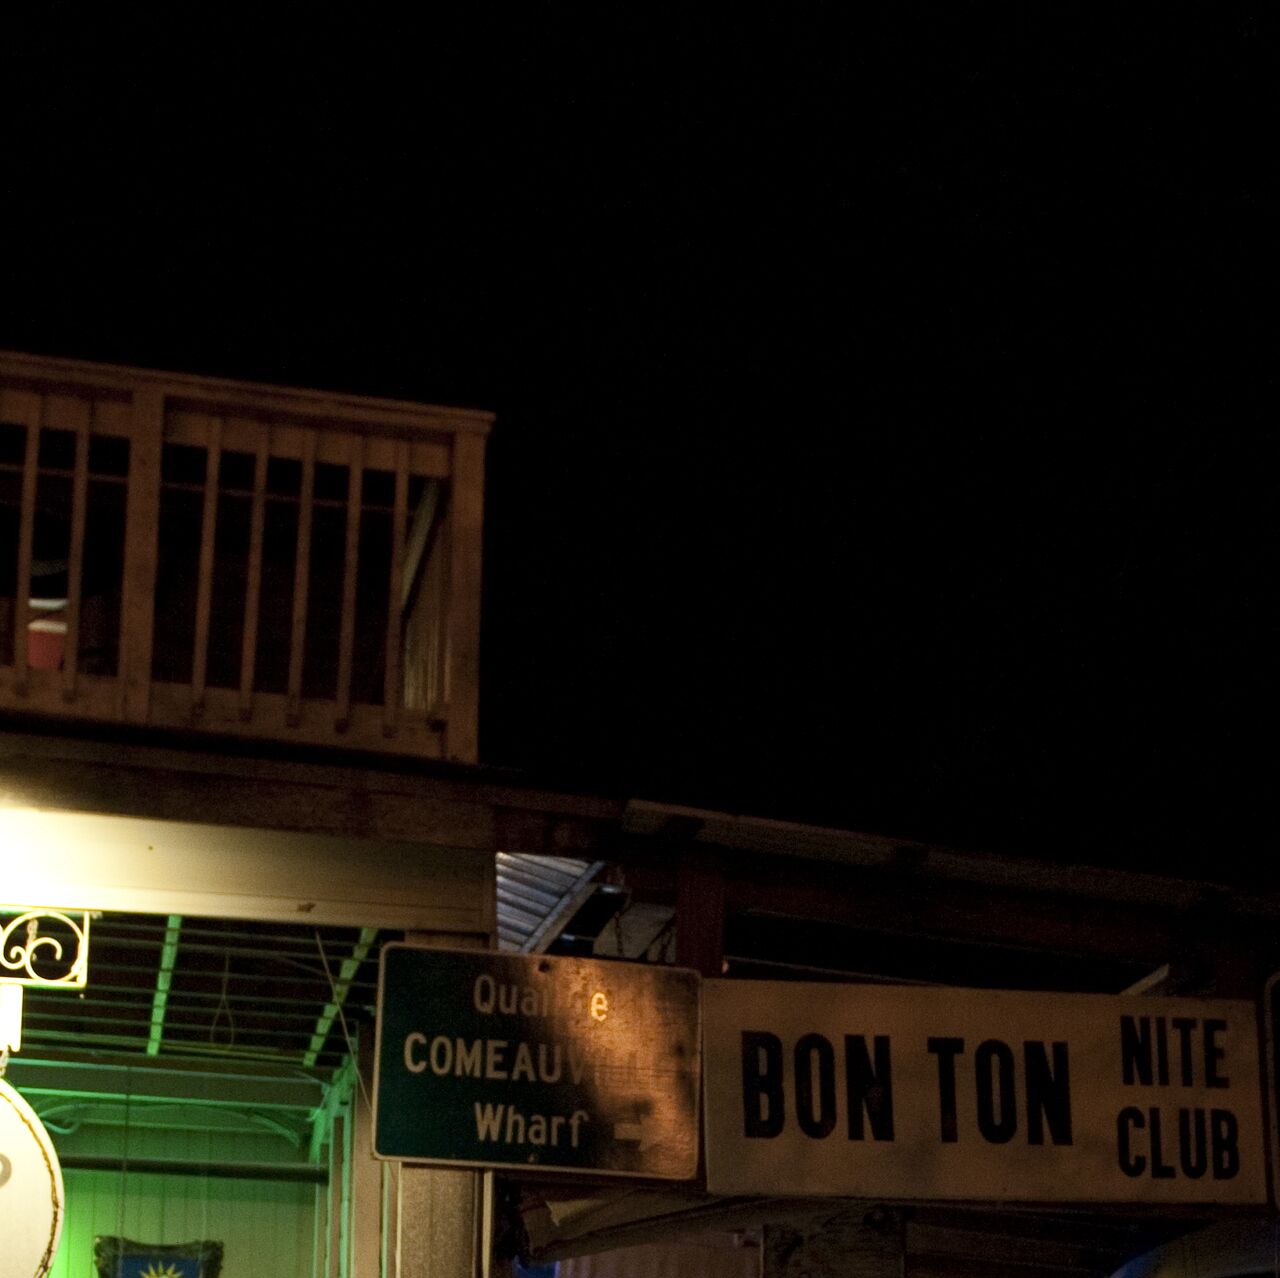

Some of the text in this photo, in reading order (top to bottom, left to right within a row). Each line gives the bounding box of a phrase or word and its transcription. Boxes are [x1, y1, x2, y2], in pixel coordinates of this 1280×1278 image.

[741, 1029, 1074, 1147] BON TON
[1119, 1014, 1230, 1089] NITE
[473, 1100, 590, 1149] Wharf
[1116, 1105, 1241, 1180] CLUB
